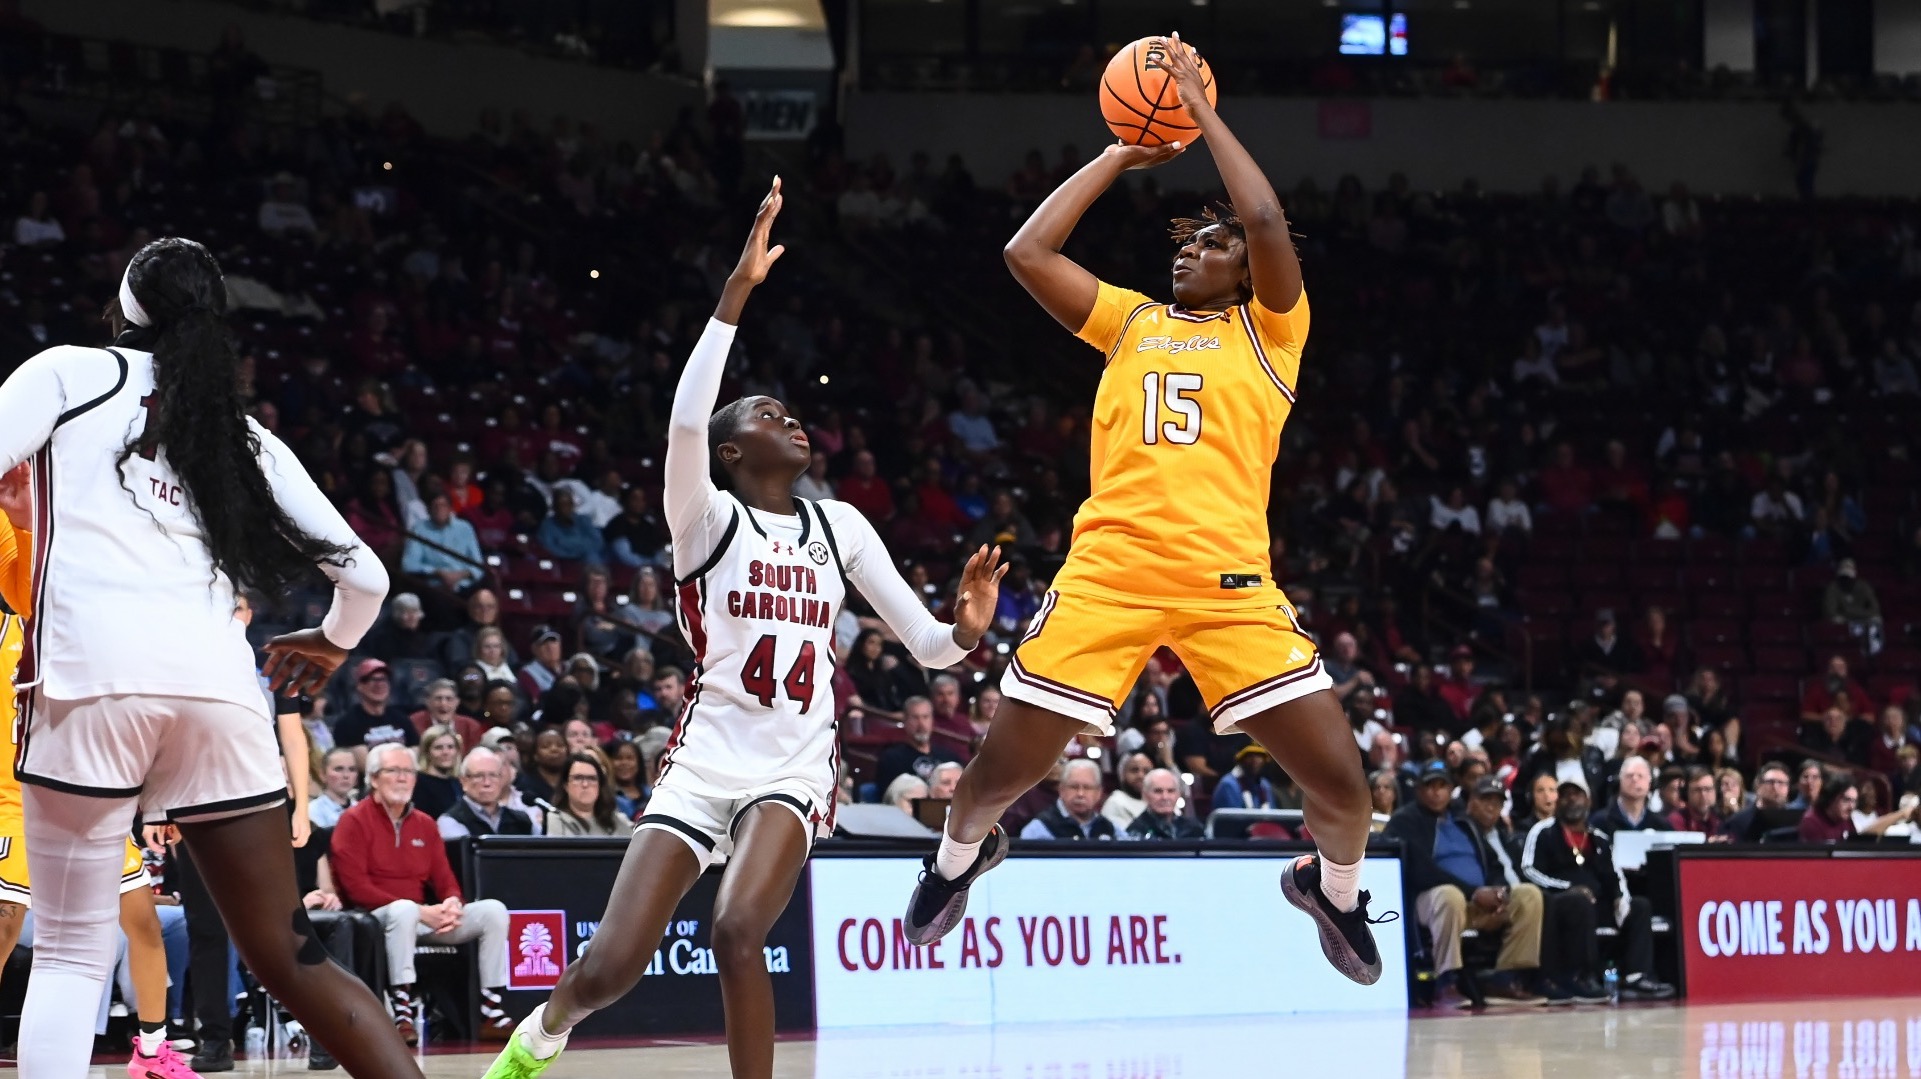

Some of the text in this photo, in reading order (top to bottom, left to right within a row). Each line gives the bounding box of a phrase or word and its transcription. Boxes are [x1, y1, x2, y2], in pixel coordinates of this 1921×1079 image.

[1137, 335, 1221, 354] Eagles
[1143, 371, 1203, 445] 15
[149, 477, 181, 506] TAC
[749, 559, 817, 594] SOUTH
[727, 590, 830, 629] CAROLINA
[740, 633, 815, 715] 44
[676, 920, 698, 936] OF
[961, 917, 1003, 968] AS
[1018, 916, 1091, 966] YOU
[1108, 915, 1182, 965] ARE.
[1698, 900, 1785, 957] COME
[1793, 899, 1830, 954] AS
[1835, 898, 1897, 953] YOU
